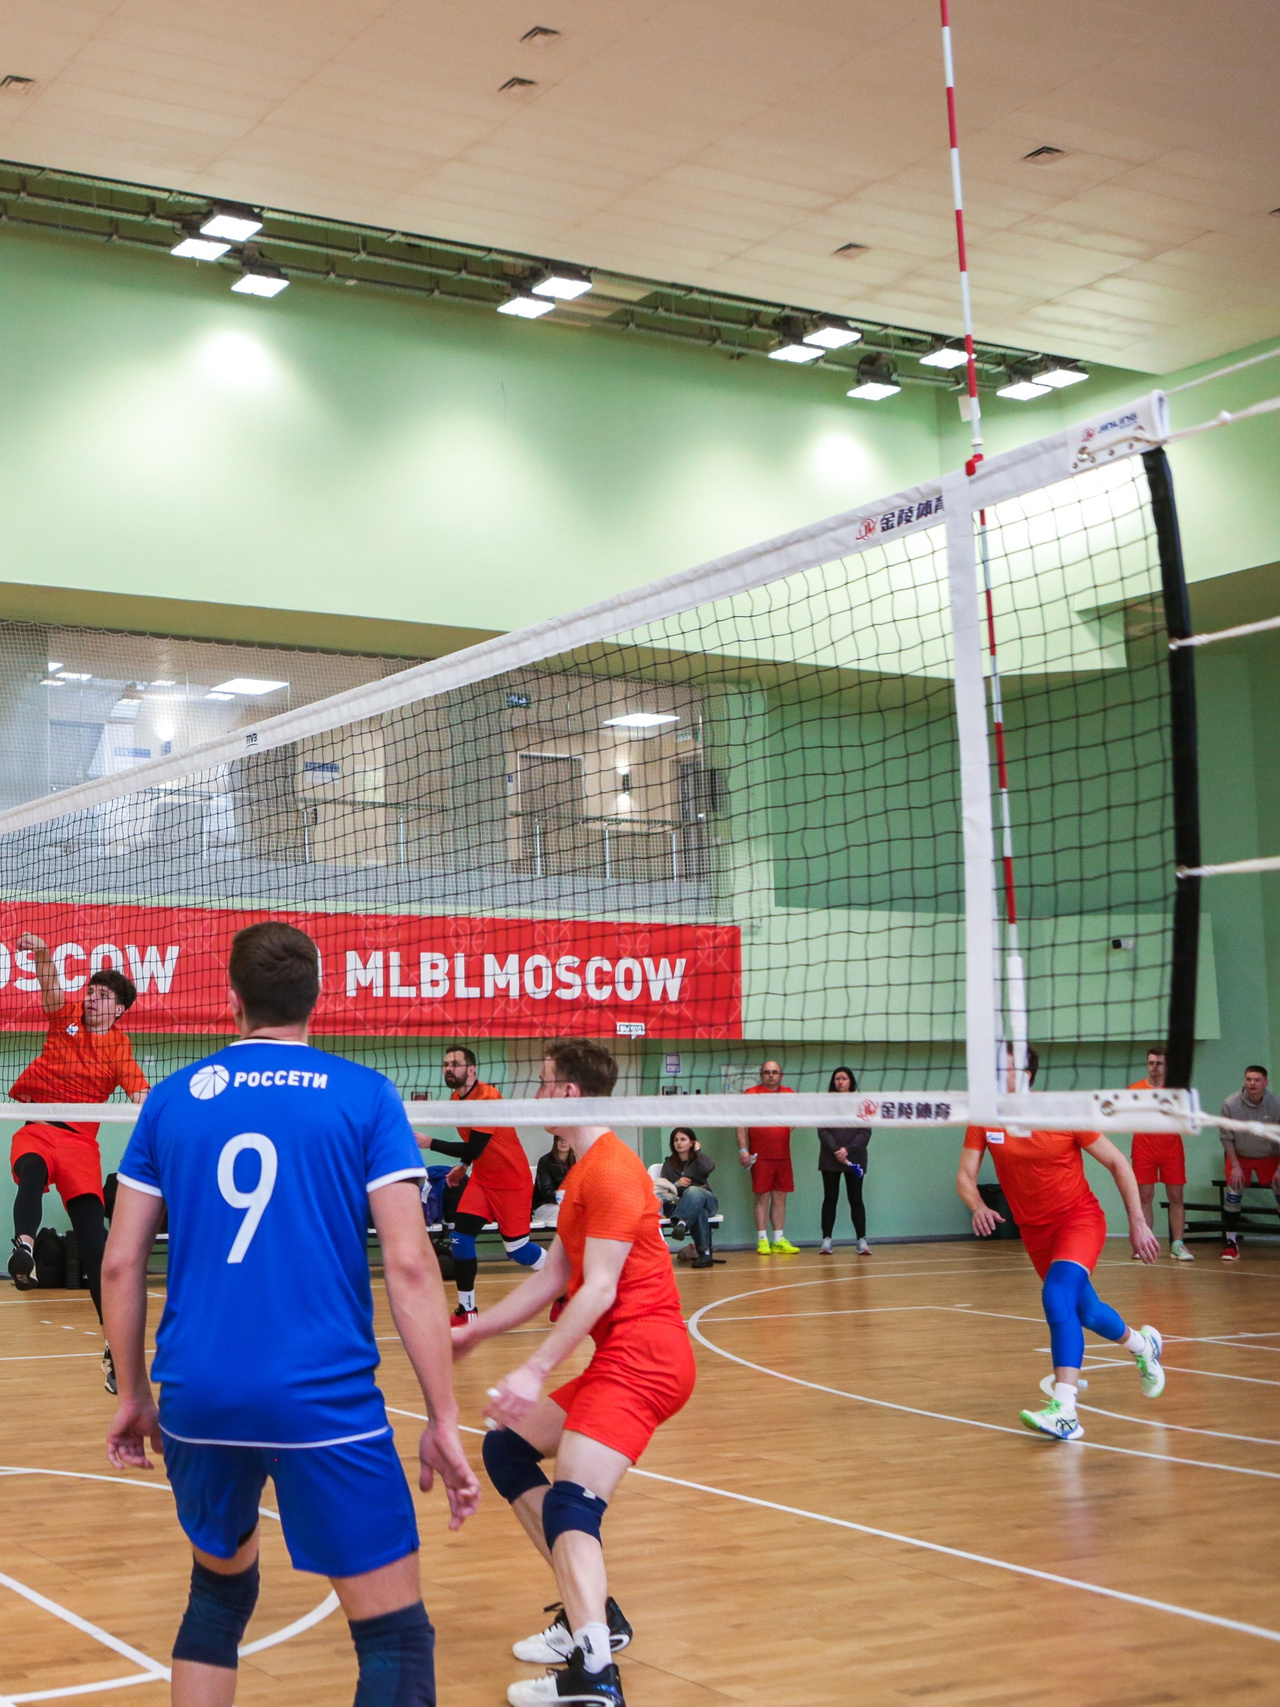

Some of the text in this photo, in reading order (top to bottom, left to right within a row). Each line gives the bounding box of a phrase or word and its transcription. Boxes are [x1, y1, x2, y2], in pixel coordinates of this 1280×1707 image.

[345, 950, 687, 1002] MLBLMOSCOW
[233, 1070, 328, 1089] РОССЕТИ
[217, 1132, 278, 1264] 9
